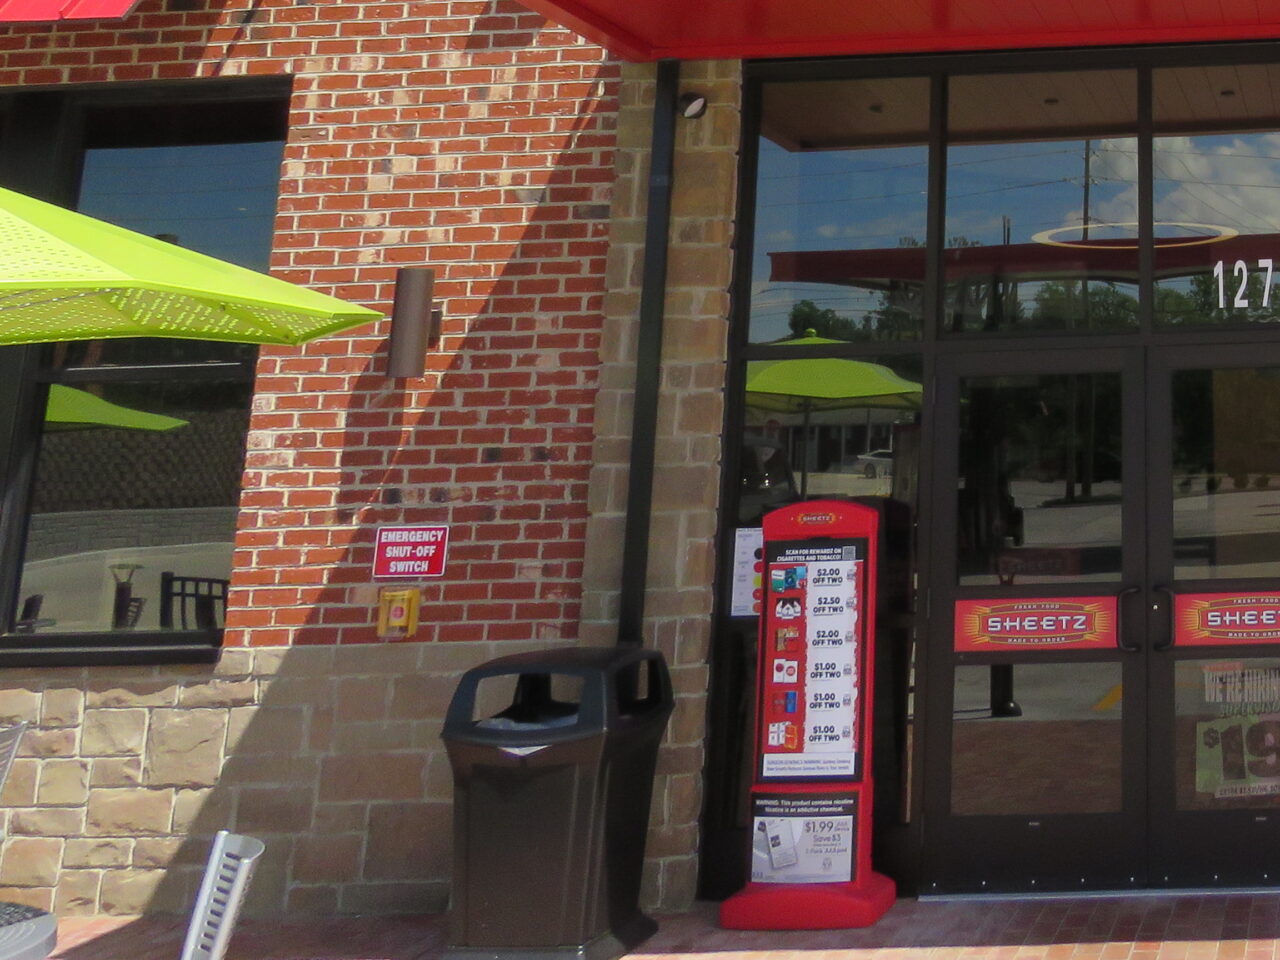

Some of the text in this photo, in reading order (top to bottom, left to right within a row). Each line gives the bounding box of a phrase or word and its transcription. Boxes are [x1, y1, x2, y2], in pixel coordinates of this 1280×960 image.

[381, 530, 444, 543] EMERGENCY
[385, 545, 437, 558] SHUT-OFF
[389, 561, 429, 573] SWITCH
[817, 568, 840, 577] $2.00
[818, 597, 840, 605] $2.50
[988, 615, 1087, 631] SHEETZ
[816, 630, 840, 638] $2.00
[814, 662, 836, 670] $1.00
[814, 693, 836, 701] $1.00
[813, 726, 835, 734] $1.00
[805, 820, 834, 833] $1.99
[813, 834, 832, 842] Save
